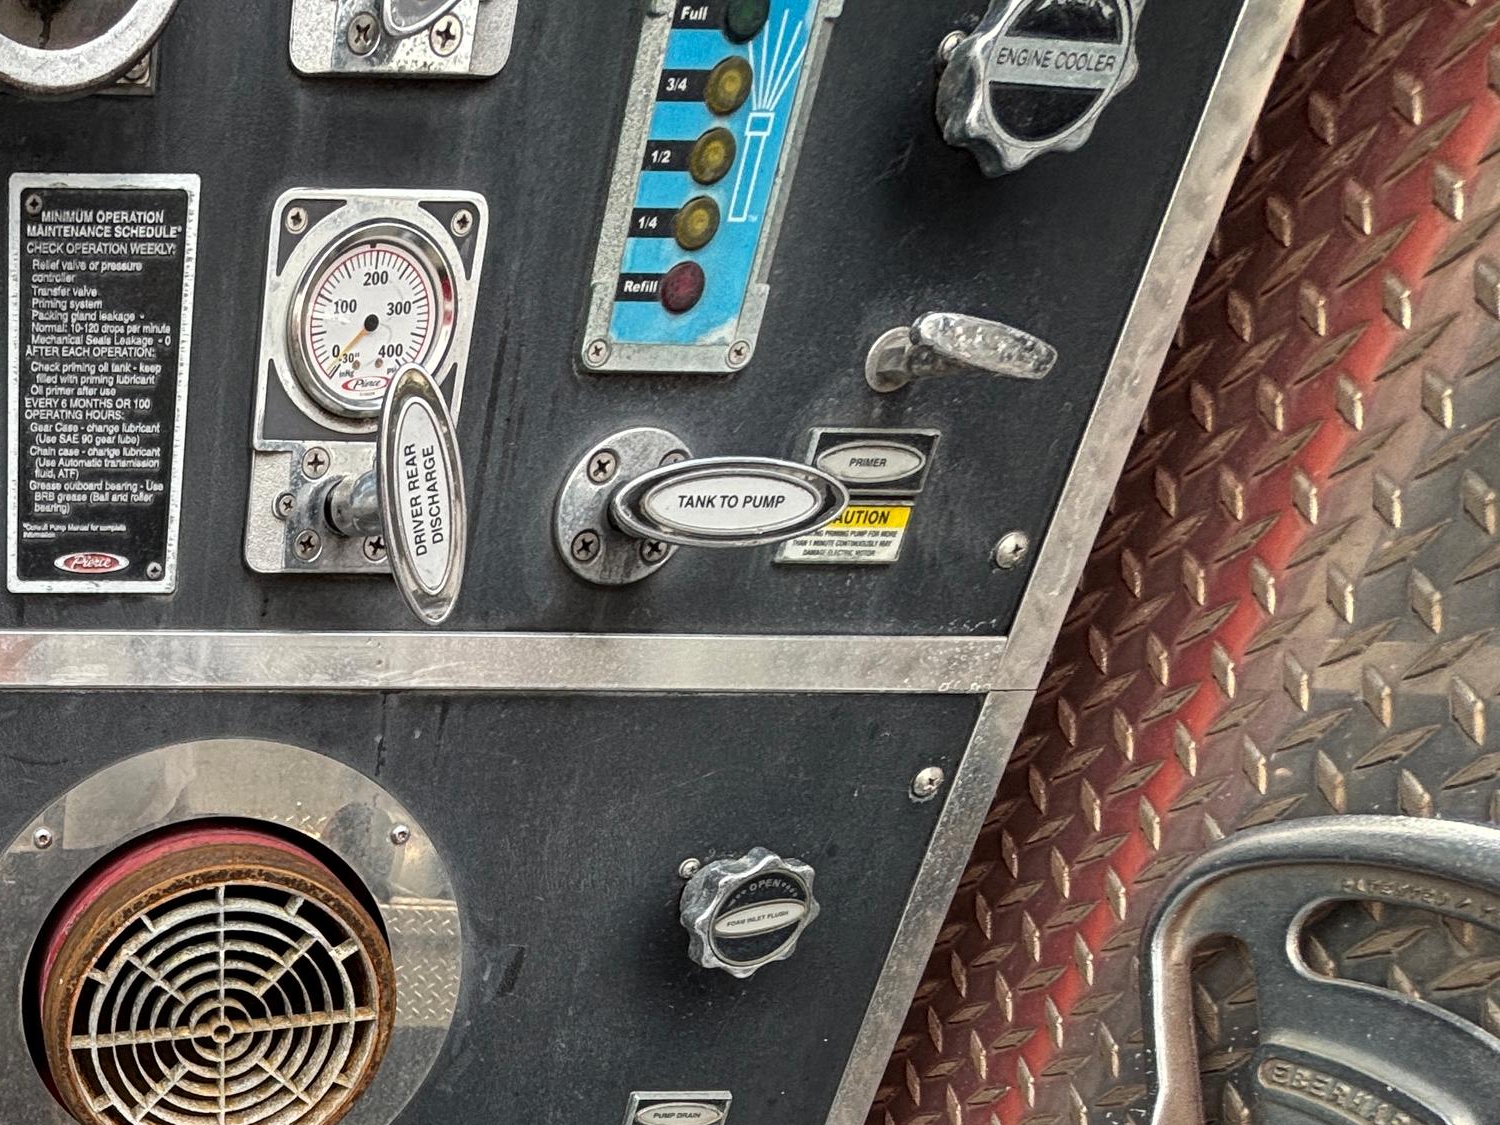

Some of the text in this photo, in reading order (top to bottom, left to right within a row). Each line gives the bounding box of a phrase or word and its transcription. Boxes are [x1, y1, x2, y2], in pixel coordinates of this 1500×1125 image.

[680, 6, 708, 20] Full
[997, 48, 1116, 72] ENGINE COOLER
[666, 78, 687, 91] 3/4
[651, 151, 671, 163] 1/2
[42, 210, 164, 223] MINIMUM OPERATION
[638, 217, 658, 229] 1/4
[27, 225, 111, 237] MAINTENANCE
[27, 243, 176, 255] CHECK OPERATION WEEKLY:
[363, 271, 388, 286] 200
[32, 286, 97, 296] Transfer valve
[624, 281, 658, 292] Refill
[32, 299, 102, 311] Priming system
[334, 300, 356, 314] 100
[387, 301, 411, 315] 300
[32, 323, 99, 332] Normal: 10-120
[26, 346, 156, 357] AFTER EACH OPERATION:
[333, 345, 340, 357] 0
[379, 345, 403, 358] 400
[354, 379, 381, 389] Pierce
[25, 399, 150, 409] EVERY 6 MONTHS OR 100
[25, 410, 124, 420] OPERATING HOURS:
[36, 434, 140, 446] (Use SAE 90 gear lube)
[849, 458, 887, 466] PRIMER
[405, 444, 427, 556] DRIVER REAR
[422, 445, 443, 544] DISCHARGE
[678, 495, 785, 508] TANK TO PUMP
[834, 511, 890, 524] AUTION
[71, 555, 112, 569] Pierce
[750, 879, 781, 891] OPEN
